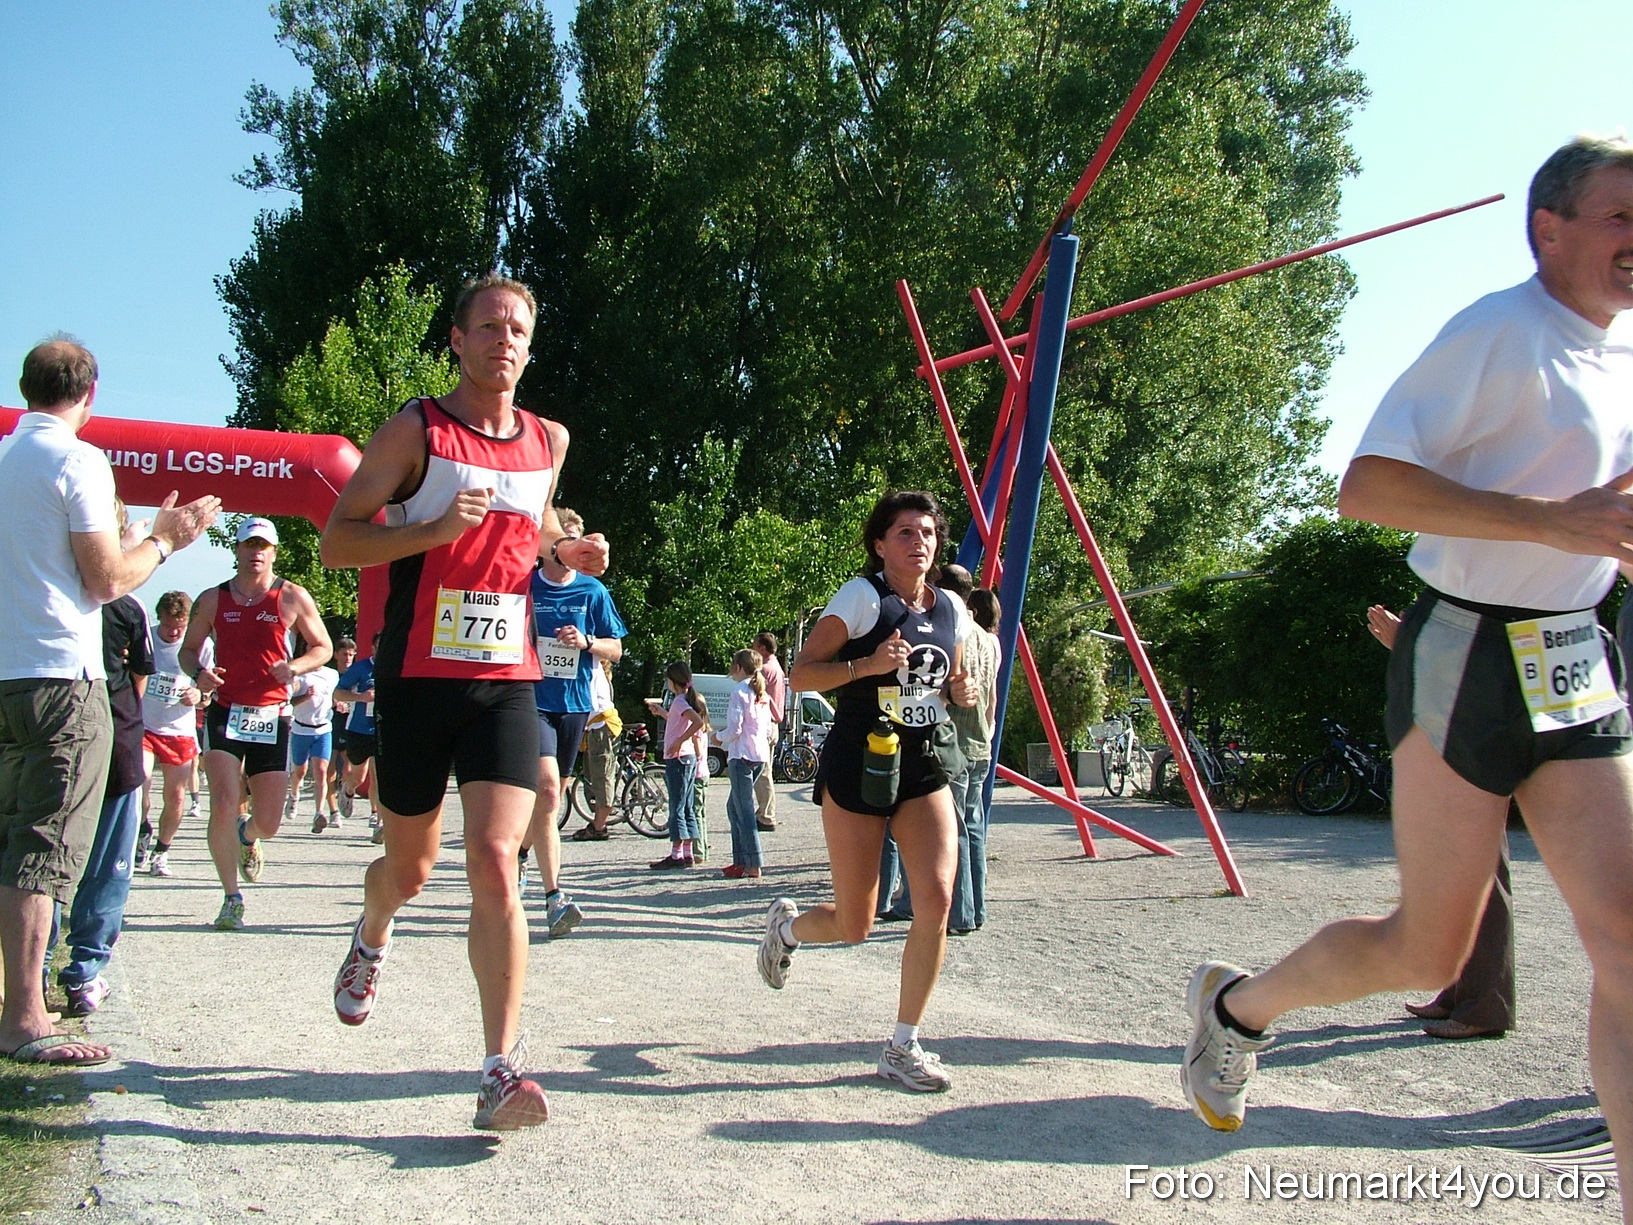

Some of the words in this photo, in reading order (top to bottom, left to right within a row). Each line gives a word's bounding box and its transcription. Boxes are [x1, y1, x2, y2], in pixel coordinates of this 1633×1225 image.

[166, 449, 295, 480] LGS-Park
[463, 591, 500, 606] Klaus
[441, 609, 453, 622] A
[464, 616, 508, 641] 776
[544, 654, 575, 668] 3534
[1523, 662, 1537, 680] B
[902, 705, 937, 724] 830
[240, 718, 274, 734] 2899
